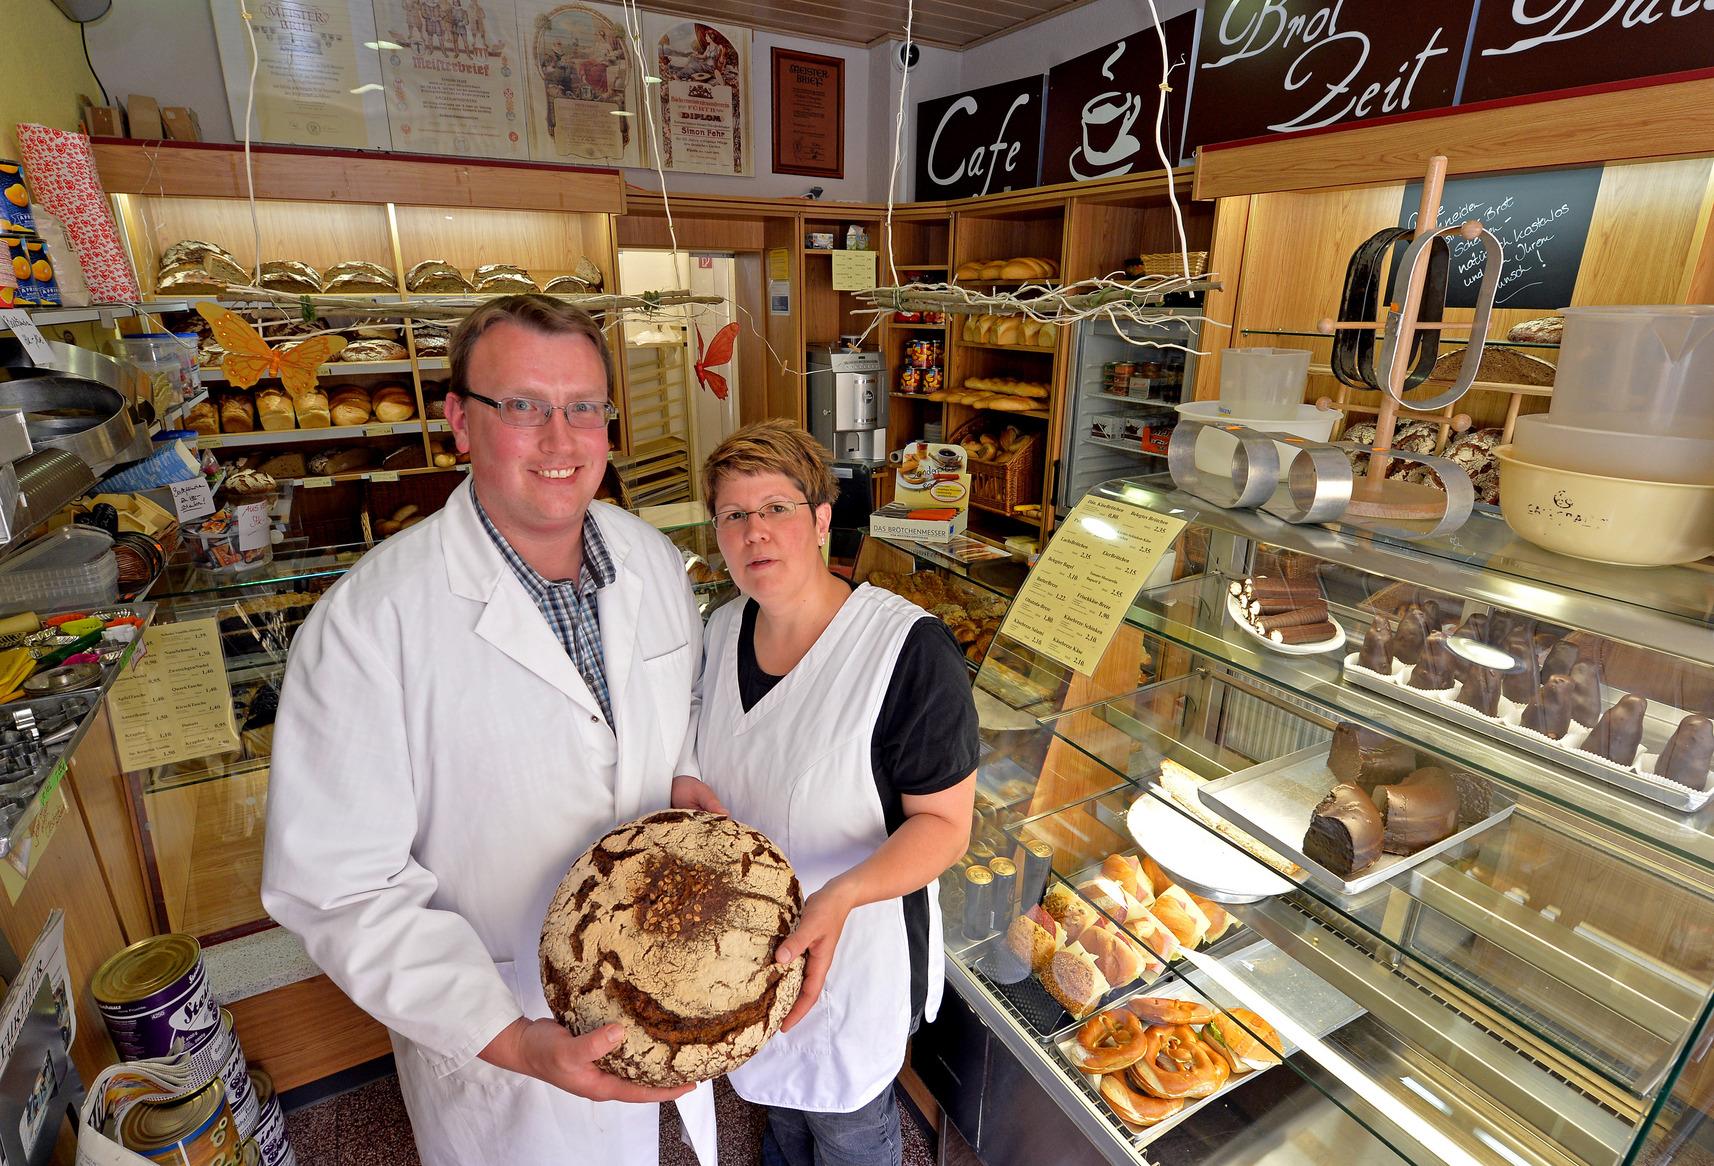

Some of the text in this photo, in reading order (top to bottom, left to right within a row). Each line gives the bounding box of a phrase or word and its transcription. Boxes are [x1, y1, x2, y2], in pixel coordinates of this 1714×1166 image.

[1266, 28, 1449, 133] Zeit
[681, 112, 722, 122] DIPLOM
[681, 127, 726, 138] Simon Fehr
[927, 93, 1030, 198] Cafe
[1484, 195, 1514, 222] Brot
